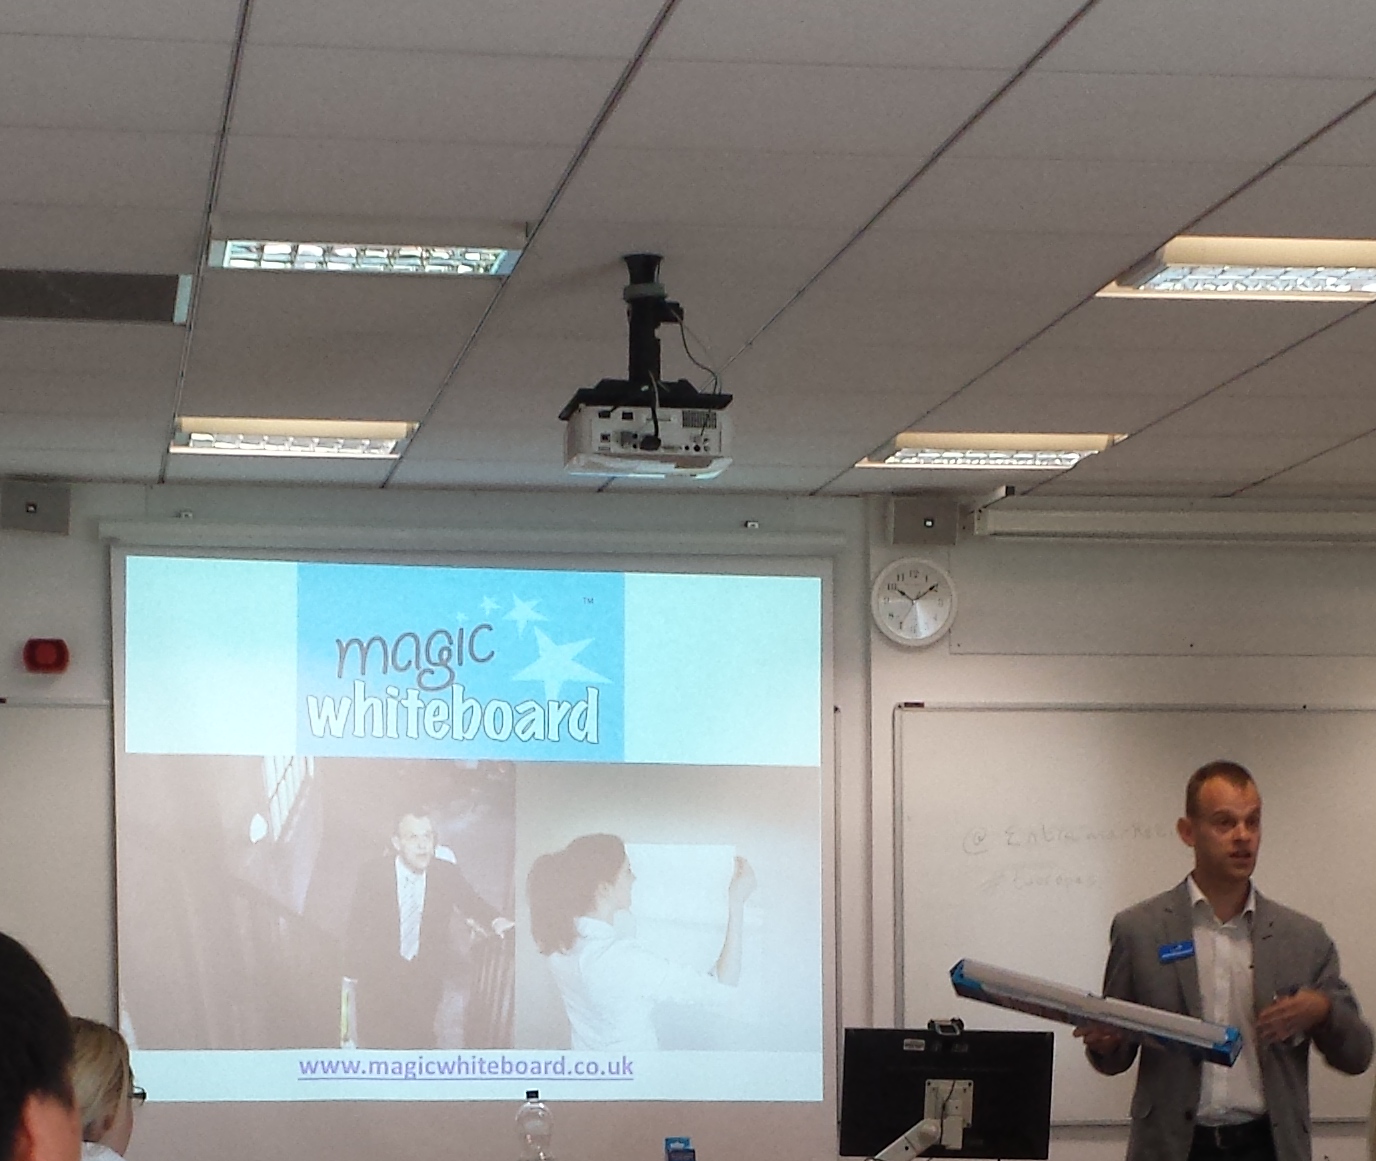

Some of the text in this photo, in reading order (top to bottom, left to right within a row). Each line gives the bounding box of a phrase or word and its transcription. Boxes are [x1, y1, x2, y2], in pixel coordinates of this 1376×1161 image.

[336, 624, 495, 692] magic
[306, 679, 599, 744] whiteboard
[298, 1055, 635, 1079] www.magicwhiteboard.co.uk
